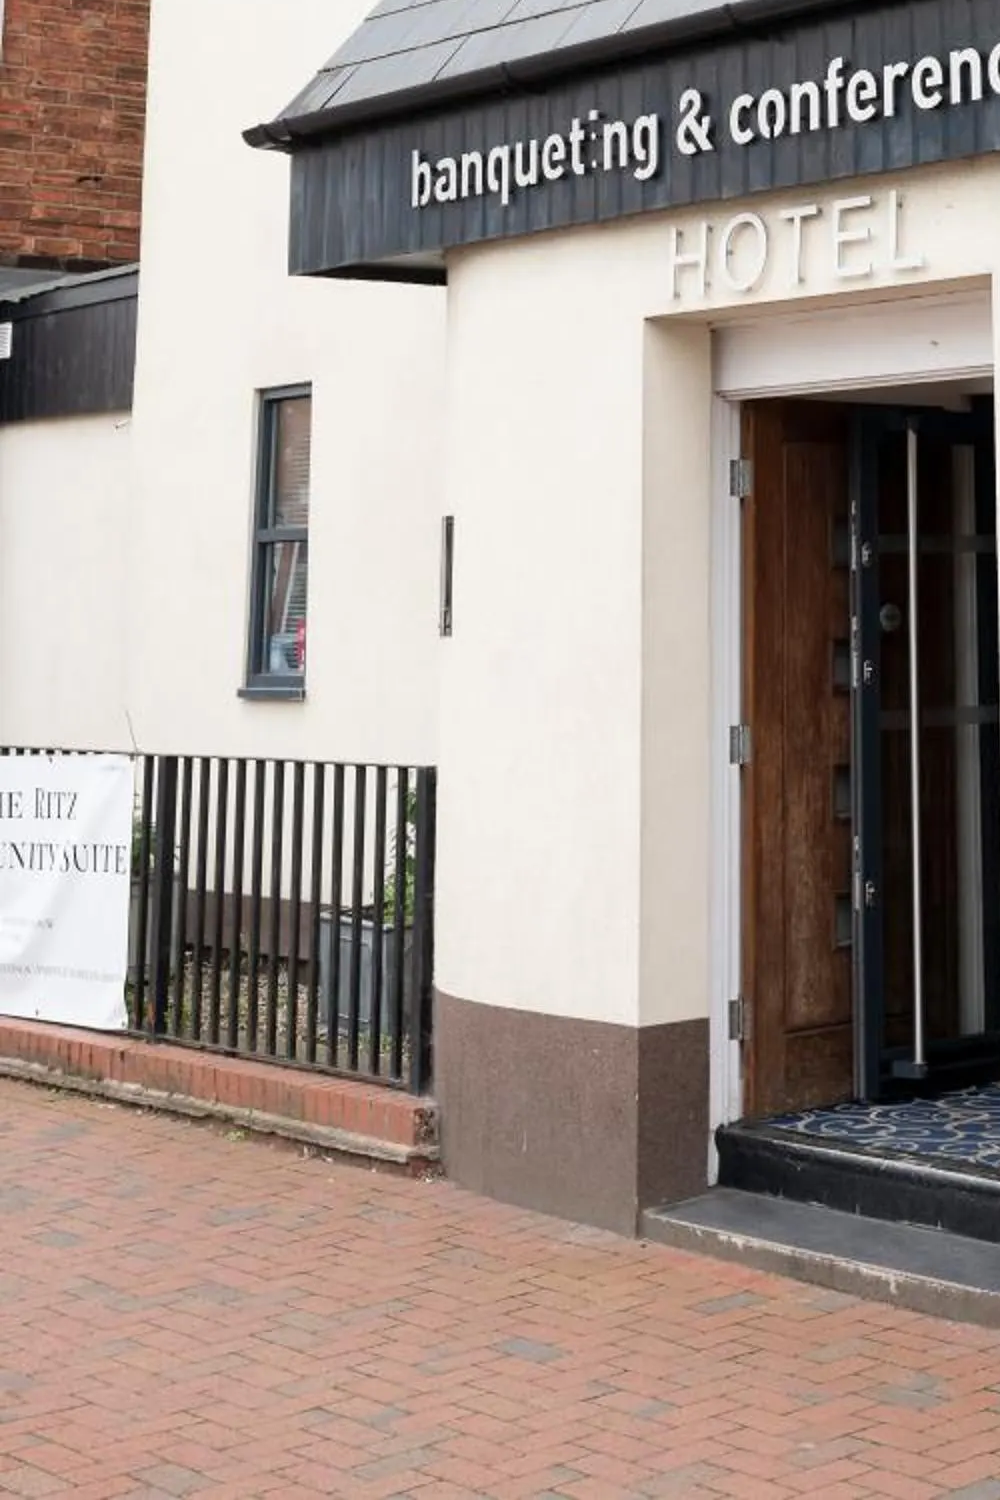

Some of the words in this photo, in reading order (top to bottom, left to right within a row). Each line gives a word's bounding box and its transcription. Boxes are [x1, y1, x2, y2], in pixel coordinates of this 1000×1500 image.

[675, 88, 713, 155] &
[669, 190, 927, 300] HOTEL
[34, 787, 79, 820] RITZ
